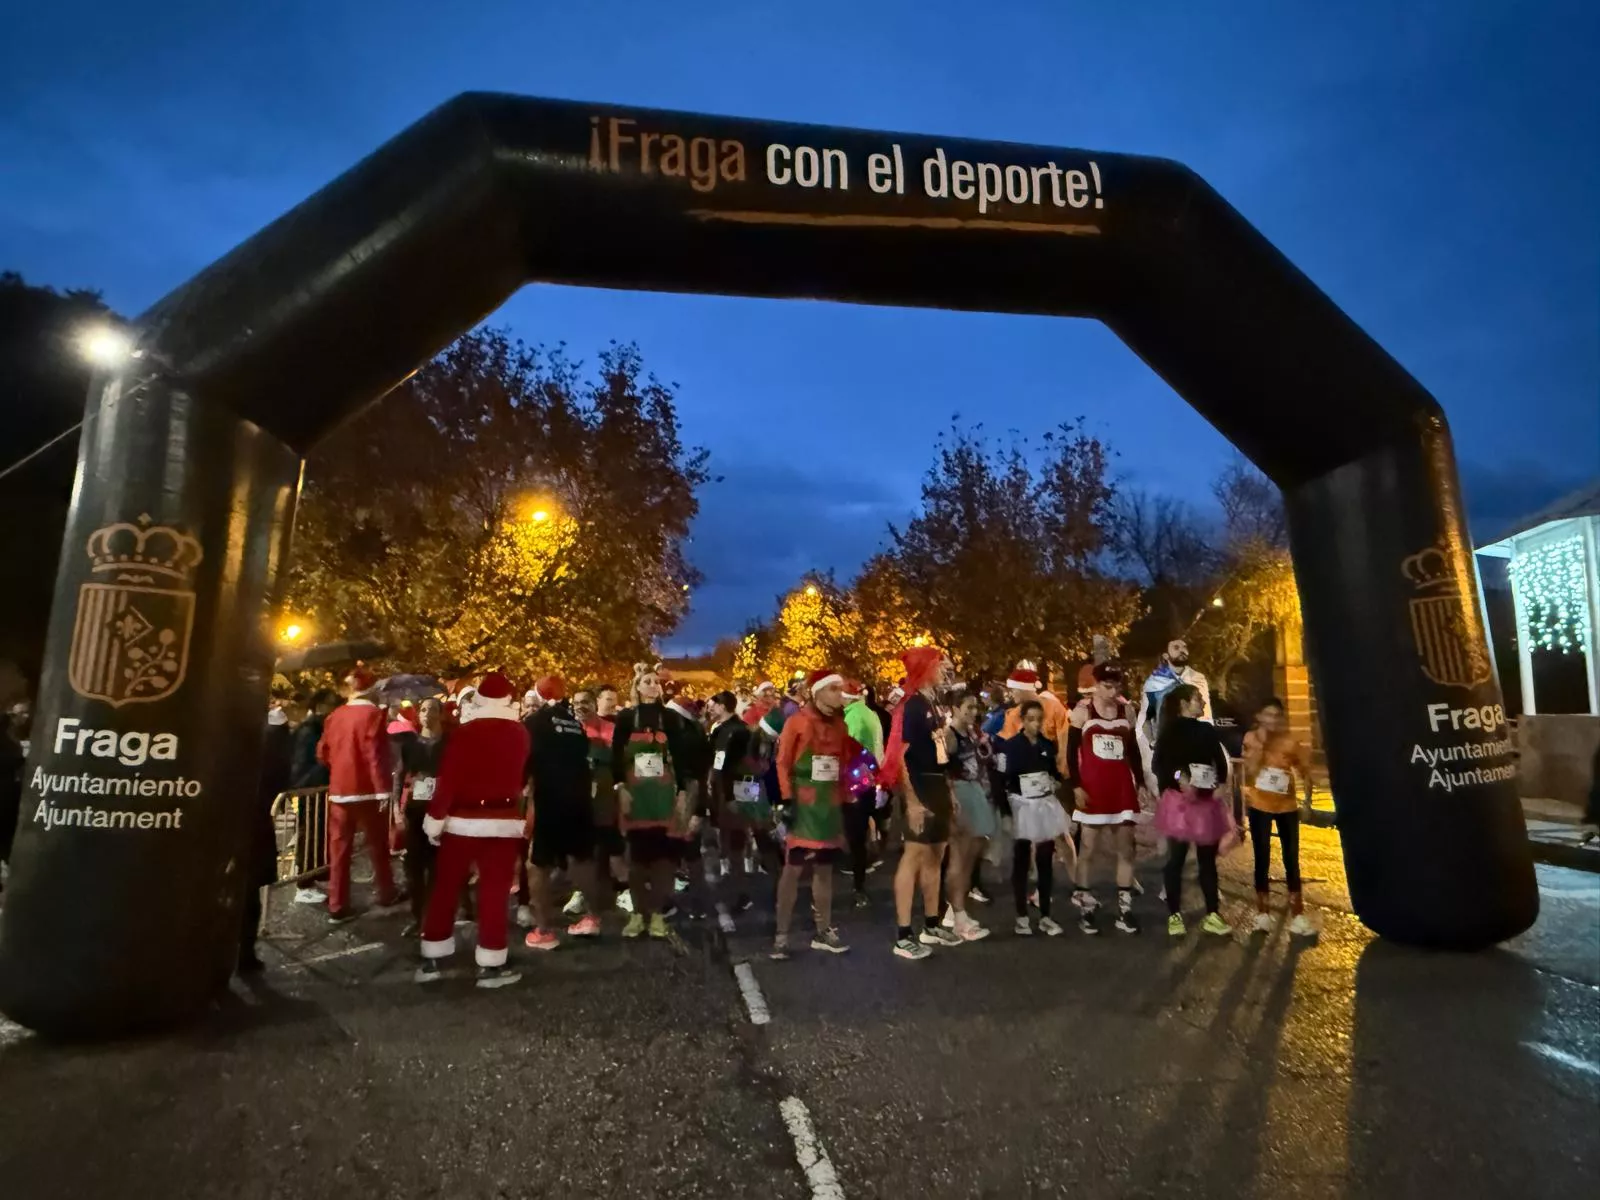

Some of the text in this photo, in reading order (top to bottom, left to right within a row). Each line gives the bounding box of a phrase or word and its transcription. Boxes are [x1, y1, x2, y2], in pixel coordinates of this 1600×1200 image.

[588, 116, 1104, 214] ¡Fraga con el deporte!
[1427, 702, 1504, 733] Fraga
[54, 718, 178, 766] Fraga
[30, 765, 202, 798] Ayuntamiento
[33, 800, 184, 832] Ajuntament
